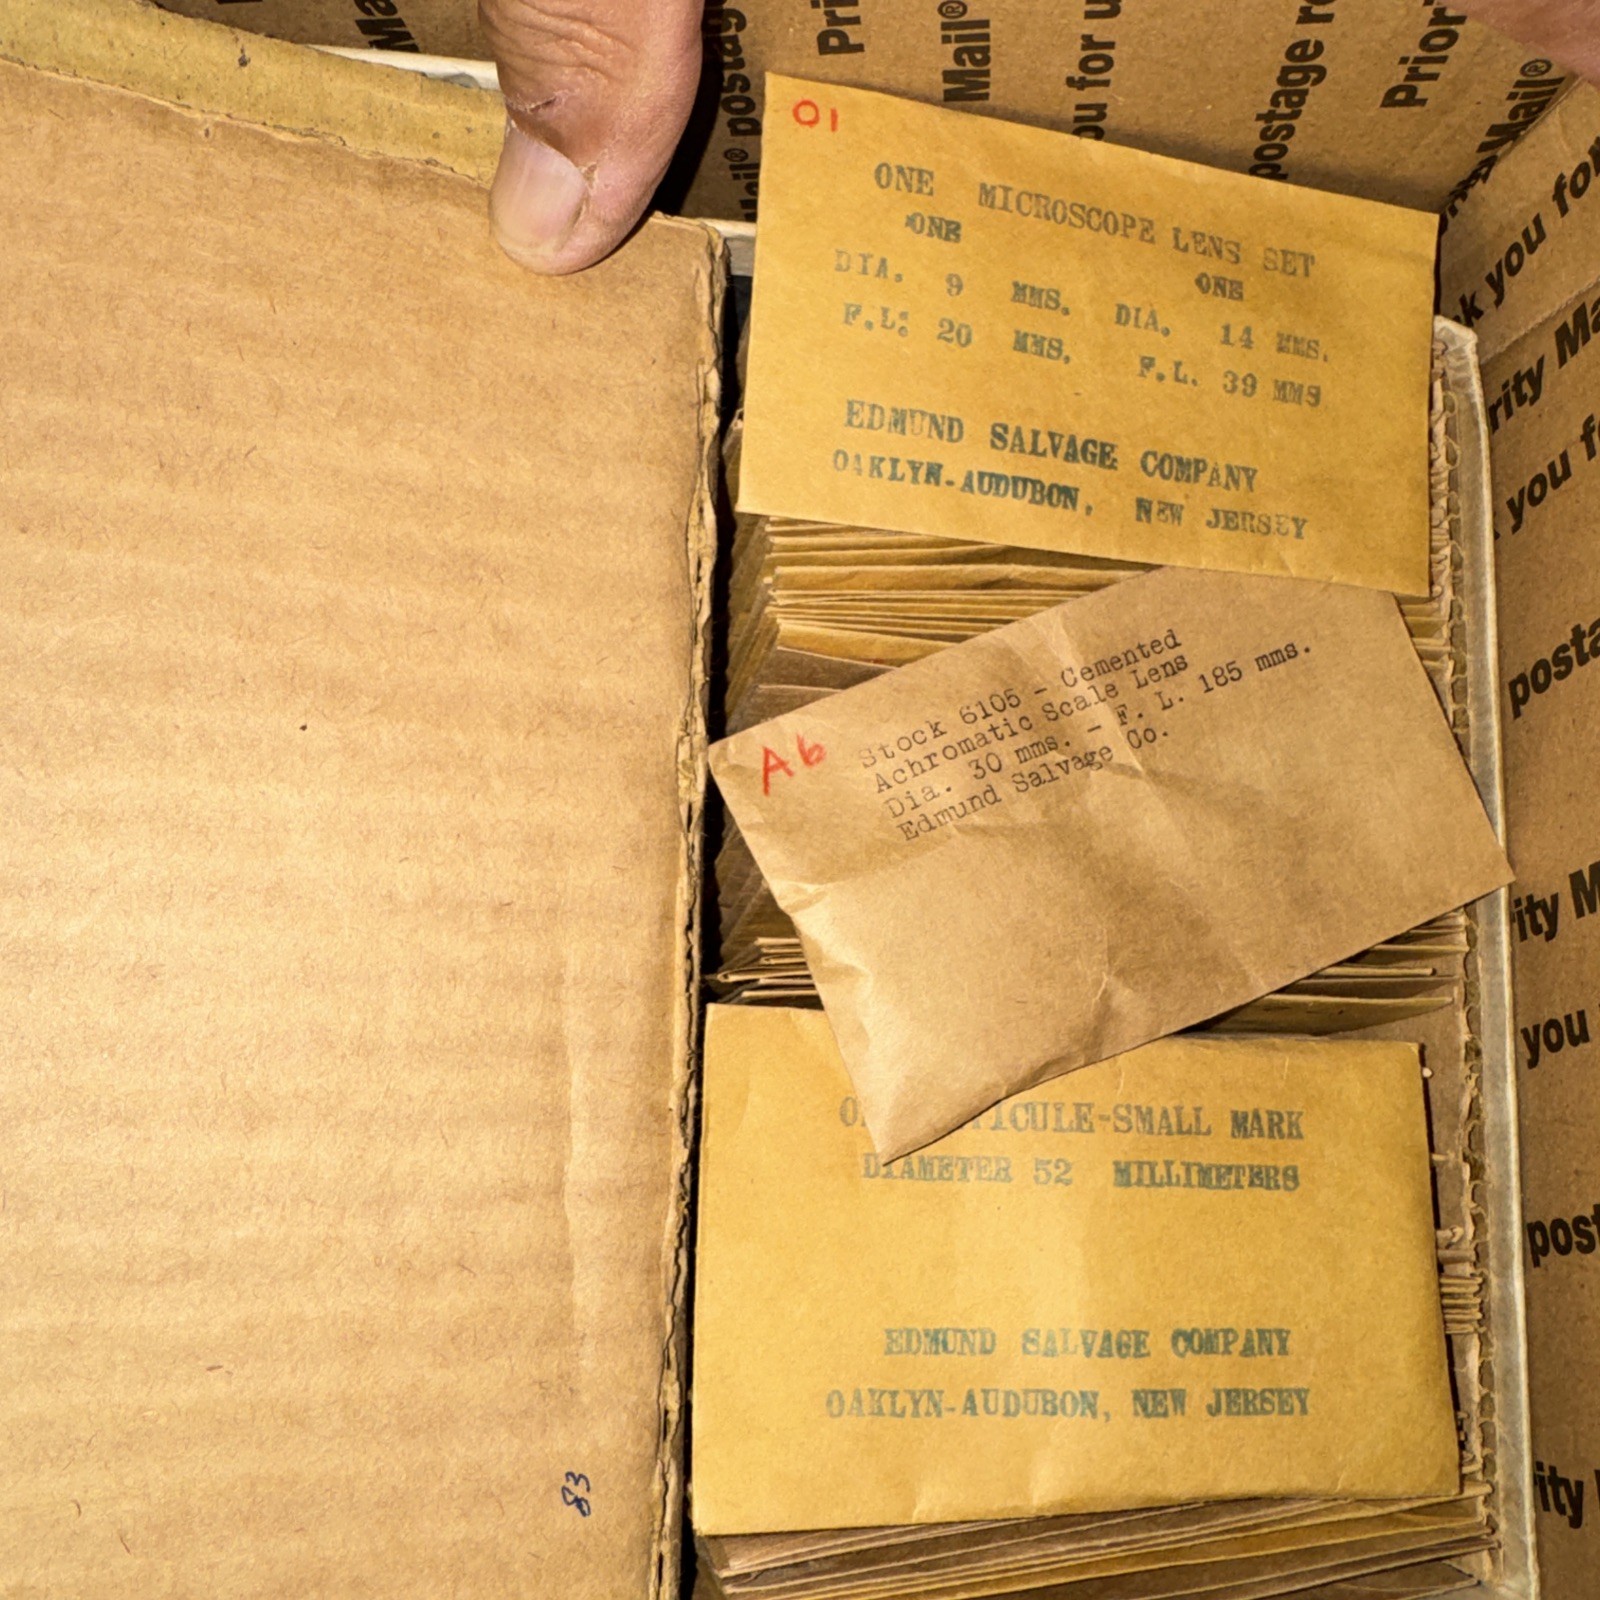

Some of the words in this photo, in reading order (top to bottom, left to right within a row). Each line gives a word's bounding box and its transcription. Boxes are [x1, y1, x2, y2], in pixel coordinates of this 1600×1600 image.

[1065, 34, 1116, 91] for
[1249, 39, 1327, 180] postage
[874, 161, 934, 197] ONE
[978, 182, 1156, 245] MICROSCOPE
[1172, 226, 1242, 265] LENS
[1262, 246, 1316, 278] SET
[834, 249, 904, 283] DIA.
[945, 273, 964, 297] 9
[1115, 303, 1171, 337] DIA.
[1220, 323, 1255, 350] 14
[1194, 271, 1244, 301] ONE
[1485, 212, 1547, 310] you
[937, 317, 973, 348] 20
[1222, 369, 1258, 398] 39
[844, 398, 965, 444] EDMUND
[989, 421, 1118, 471] SALVAGE
[1139, 450, 1258, 493] COMPANY
[1136, 497, 1185, 527] NEW
[1206, 507, 1308, 540] JERSEY
[1506, 449, 1572, 535] you
[860, 720, 948, 769] Stock
[958, 687, 1022, 725] 6105
[1060, 628, 1182, 688] Cemented
[873, 714, 1033, 794] Achromatic
[1041, 682, 1119, 722] Scale
[1131, 653, 1189, 690] Lens
[883, 783, 953, 819] Dia.
[967, 752, 1002, 780] 30
[1014, 735, 1071, 764] mms.
[1198, 660, 1243, 694] 185
[1254, 641, 1312, 672] mms.
[896, 784, 1003, 841] Edmund
[1011, 745, 1114, 793] Salvage
[1126, 726, 1169, 750] Co.
[1511, 892, 1559, 943] ity
[1520, 1009, 1590, 1070] you
[971, 1100, 1212, 1136] ICULE-SMALL
[1230, 1107, 1304, 1140] MARK
[1032, 1157, 1073, 1186] 52
[1112, 1160, 1300, 1191] MILLIMETERS
[883, 1327, 997, 1356] EDMUND
[1021, 1327, 1151, 1359] SALVAGE
[1170, 1327, 1292, 1359] COMPANY
[1131, 1387, 1187, 1419] NEW
[1205, 1387, 1311, 1418] JERSEY
[1534, 1460, 1584, 1529] ity
